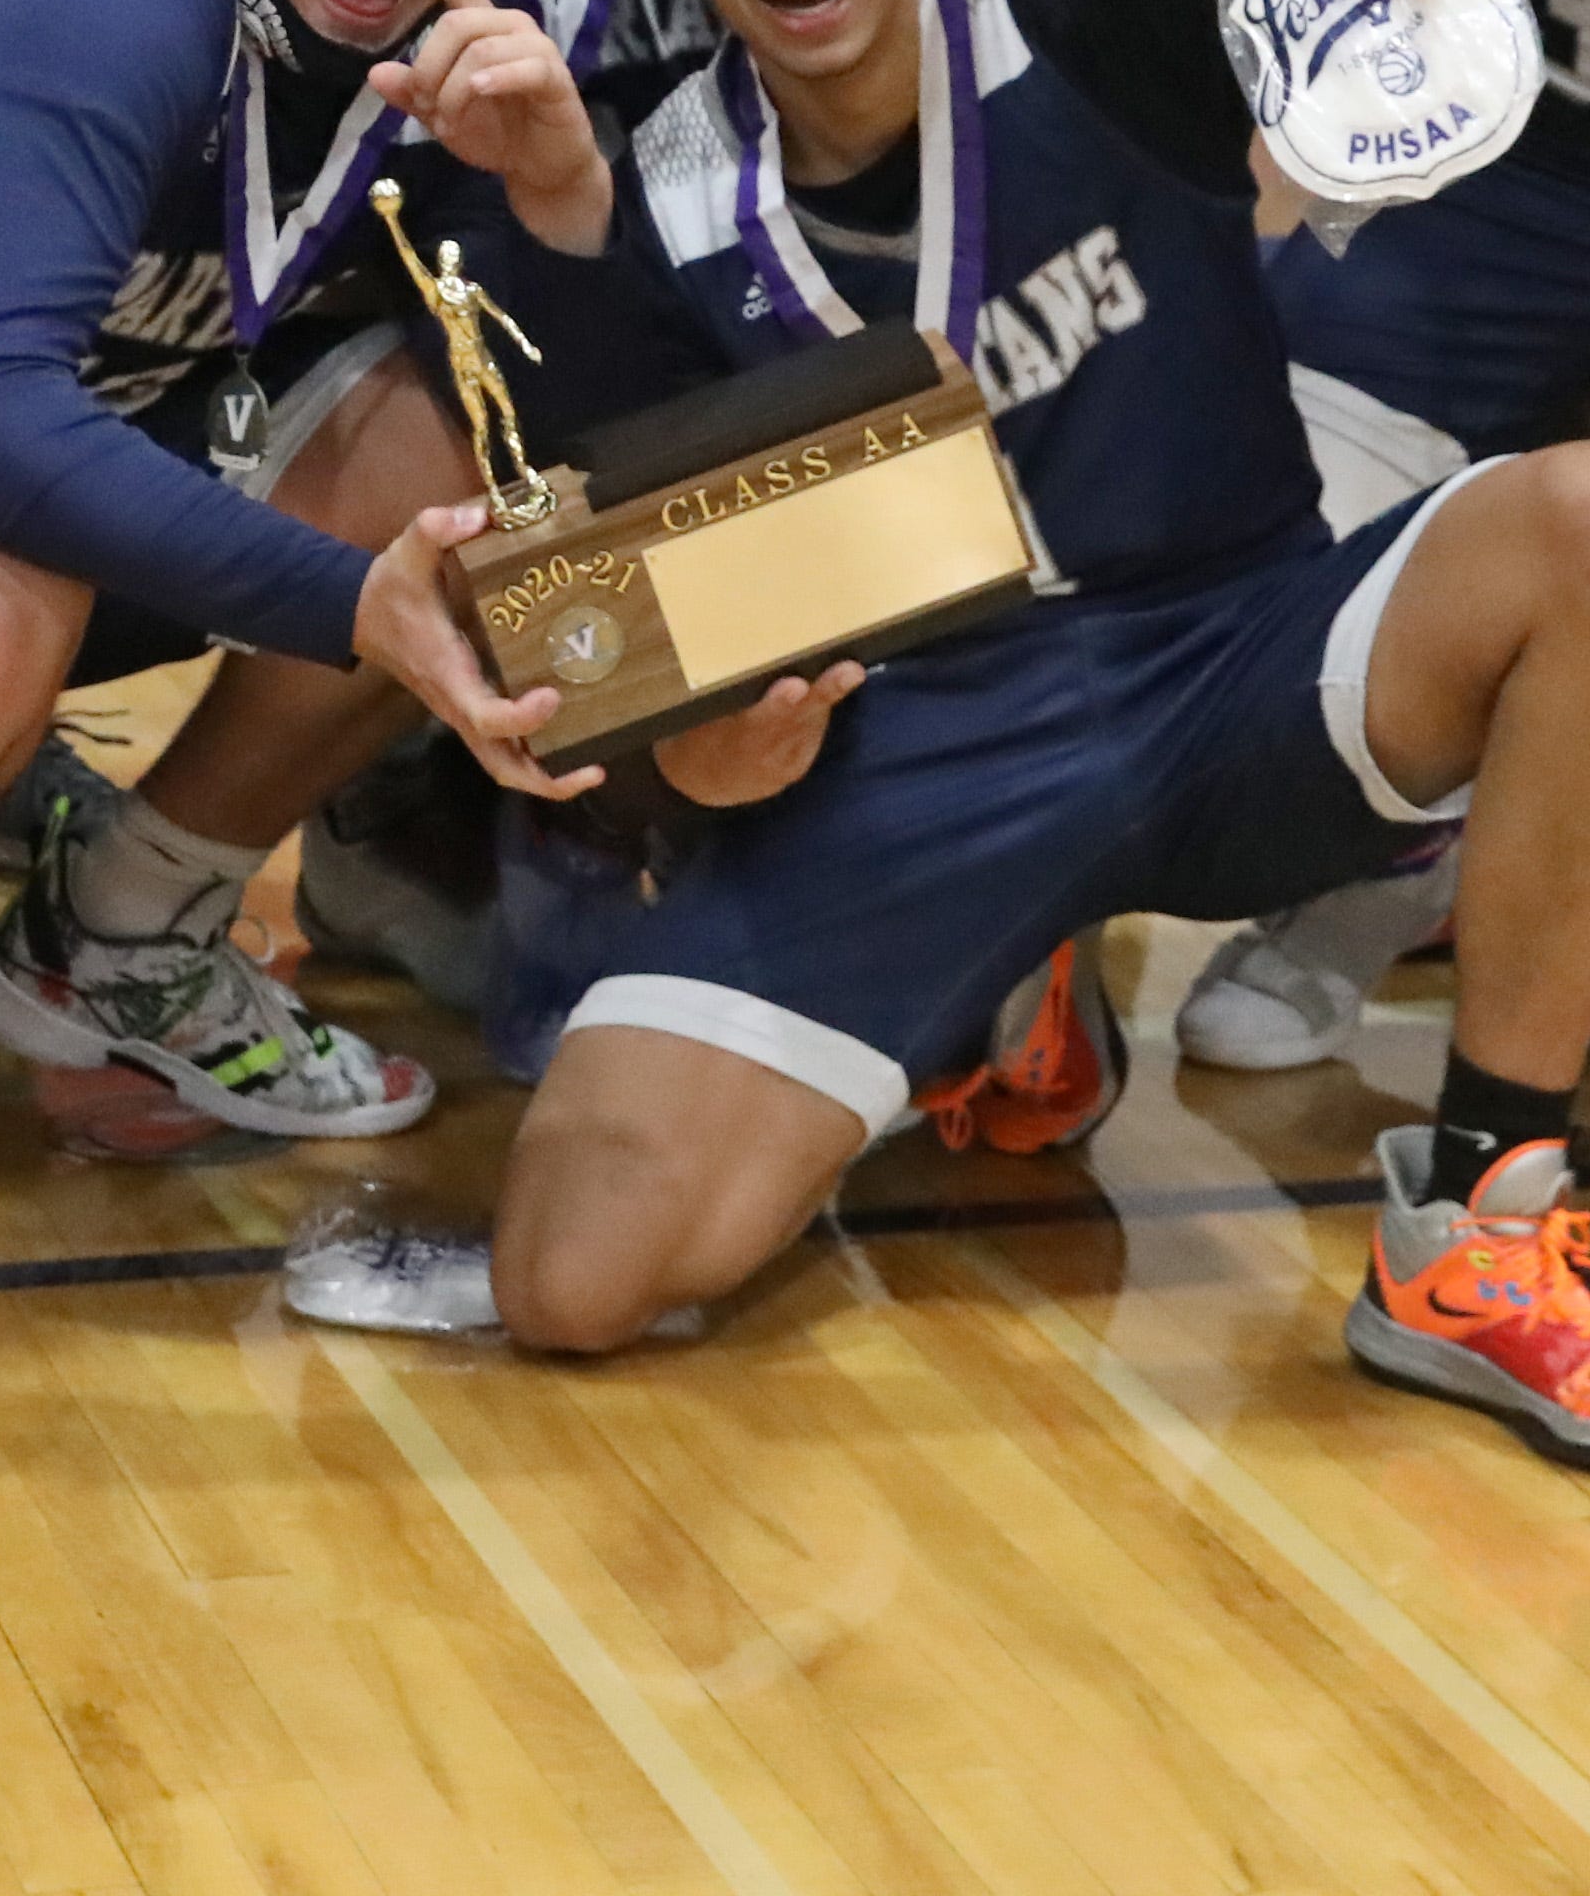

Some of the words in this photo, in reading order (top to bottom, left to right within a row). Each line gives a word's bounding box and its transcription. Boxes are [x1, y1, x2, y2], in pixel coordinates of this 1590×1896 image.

[1347, 103, 1478, 165] PHSAA
[661, 446, 833, 533] CLASS
[489, 550, 639, 633] 2020-21
